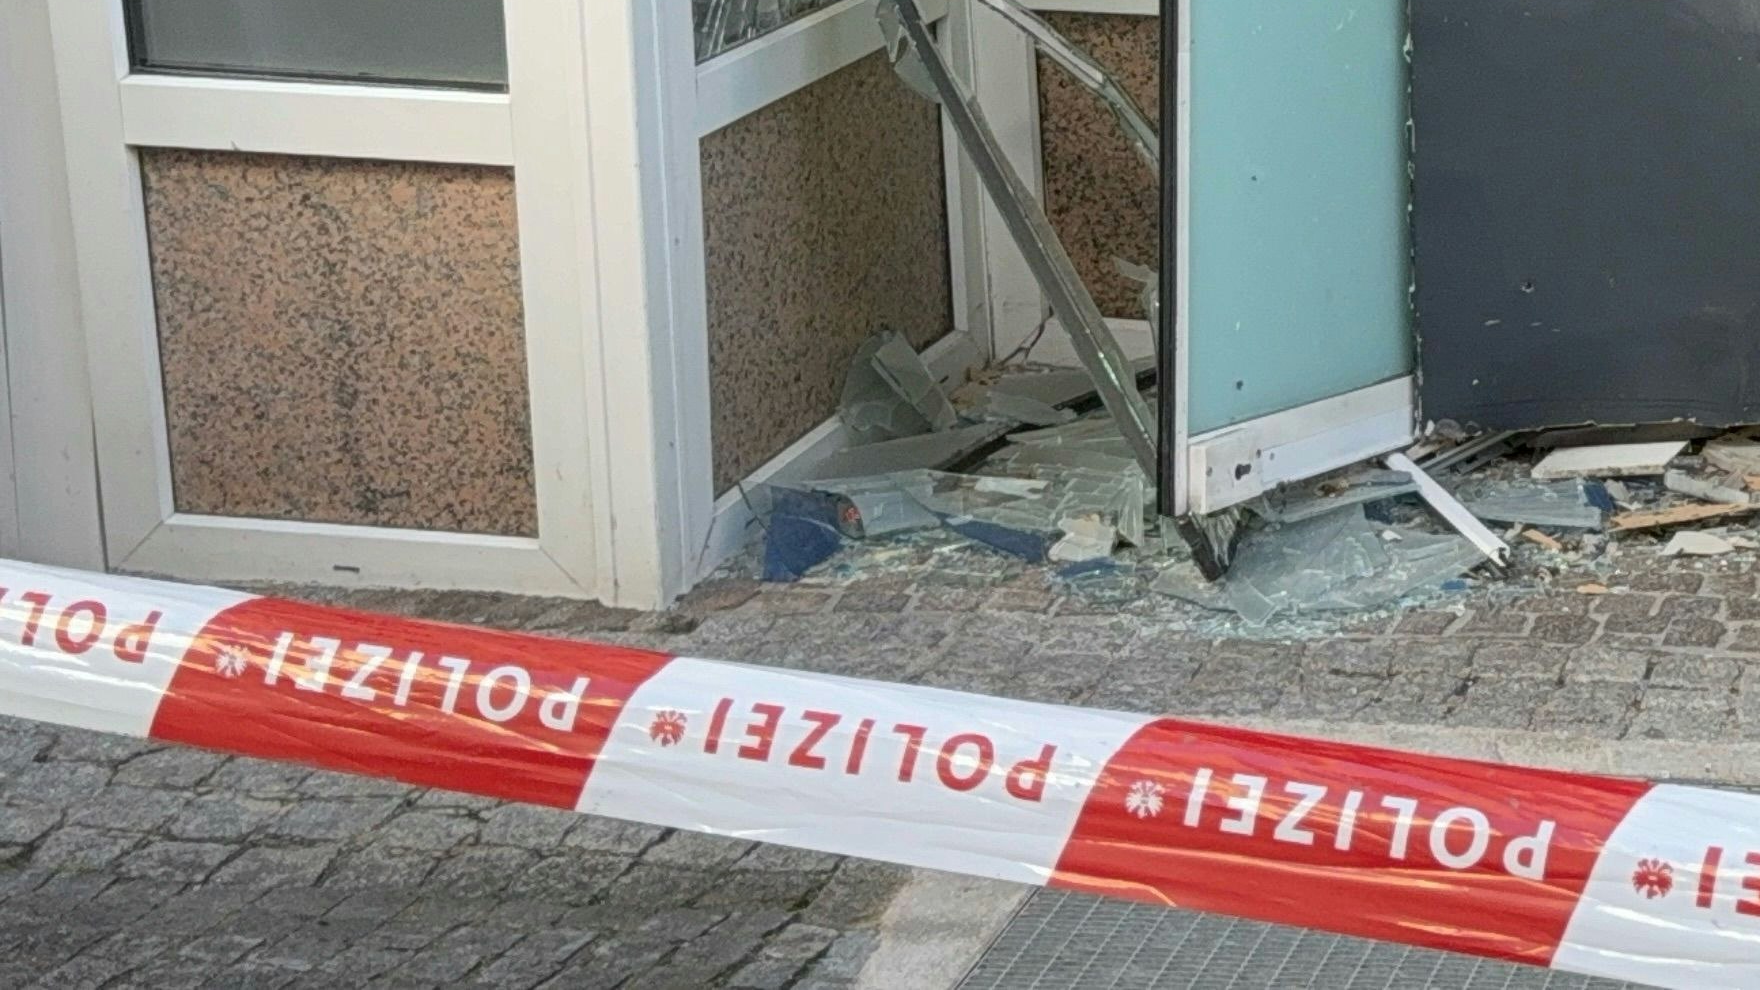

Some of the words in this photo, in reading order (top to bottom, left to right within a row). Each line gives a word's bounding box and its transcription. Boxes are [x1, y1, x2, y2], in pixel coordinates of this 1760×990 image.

[0, 587, 164, 664] POL
[264, 631, 591, 731] POLIZEI
[703, 697, 1057, 802] POLIZEI
[1183, 767, 1557, 881] POLIZEI
